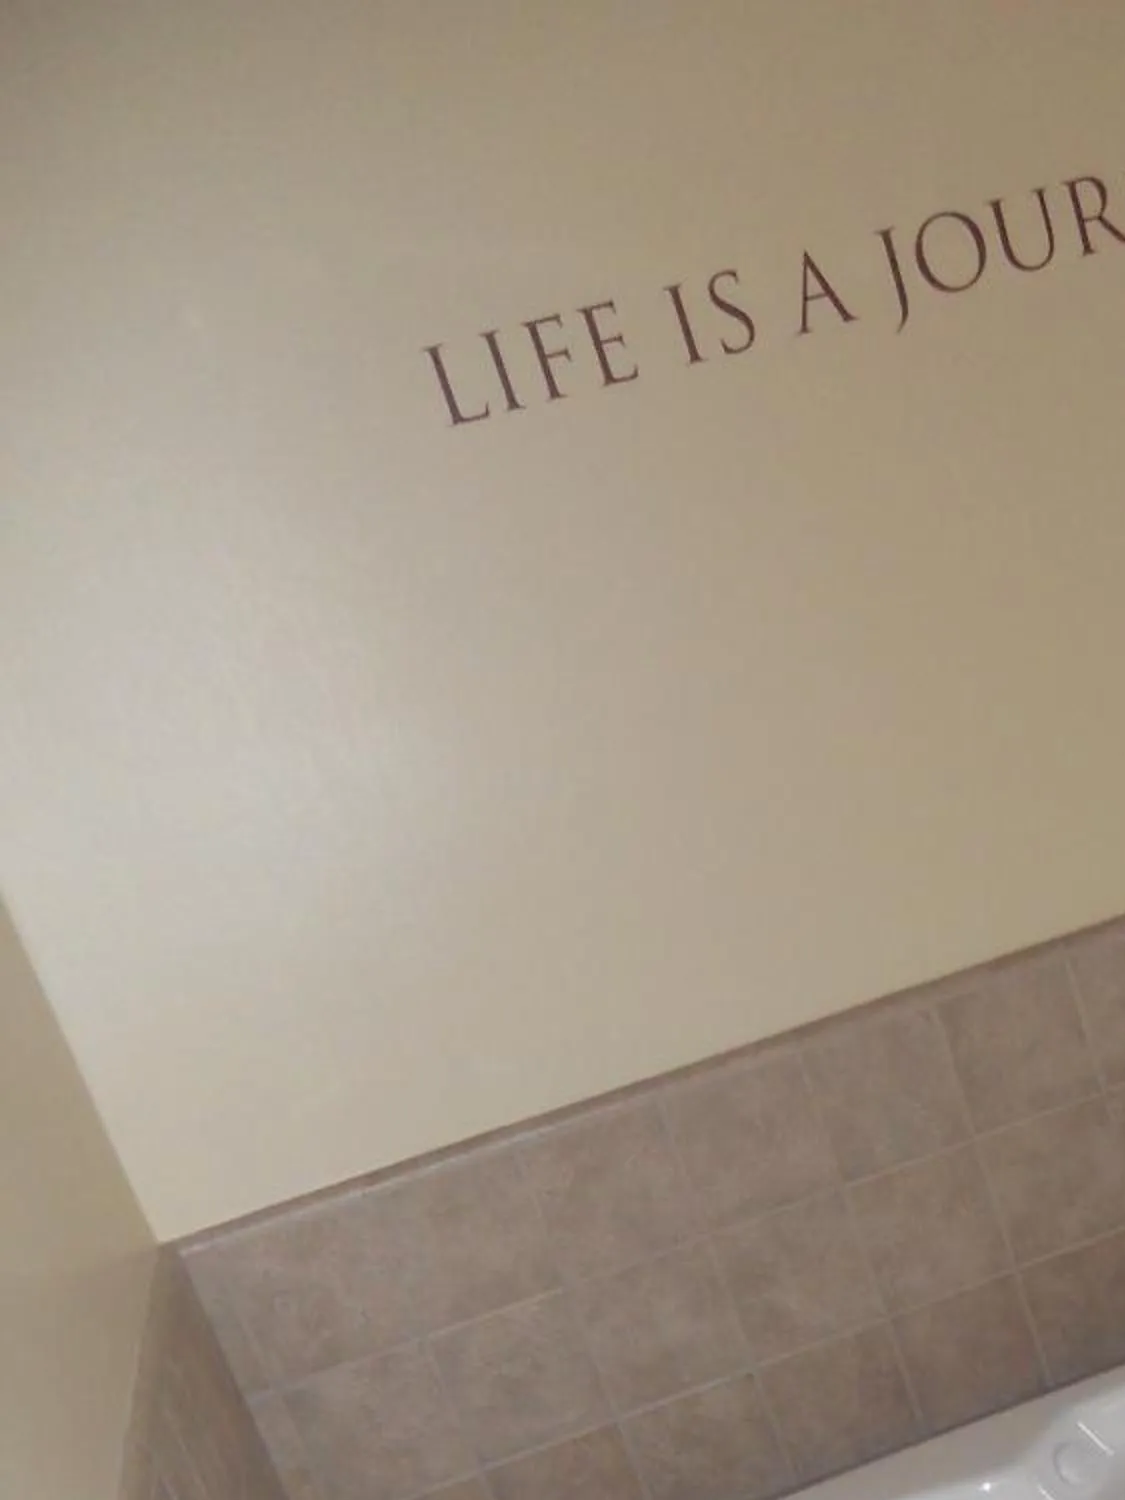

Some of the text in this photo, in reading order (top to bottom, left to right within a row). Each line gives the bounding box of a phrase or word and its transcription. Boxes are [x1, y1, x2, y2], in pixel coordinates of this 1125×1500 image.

[423, 299, 640, 427] LIFE
[662, 268, 756, 365] IS
[797, 249, 858, 336] A
